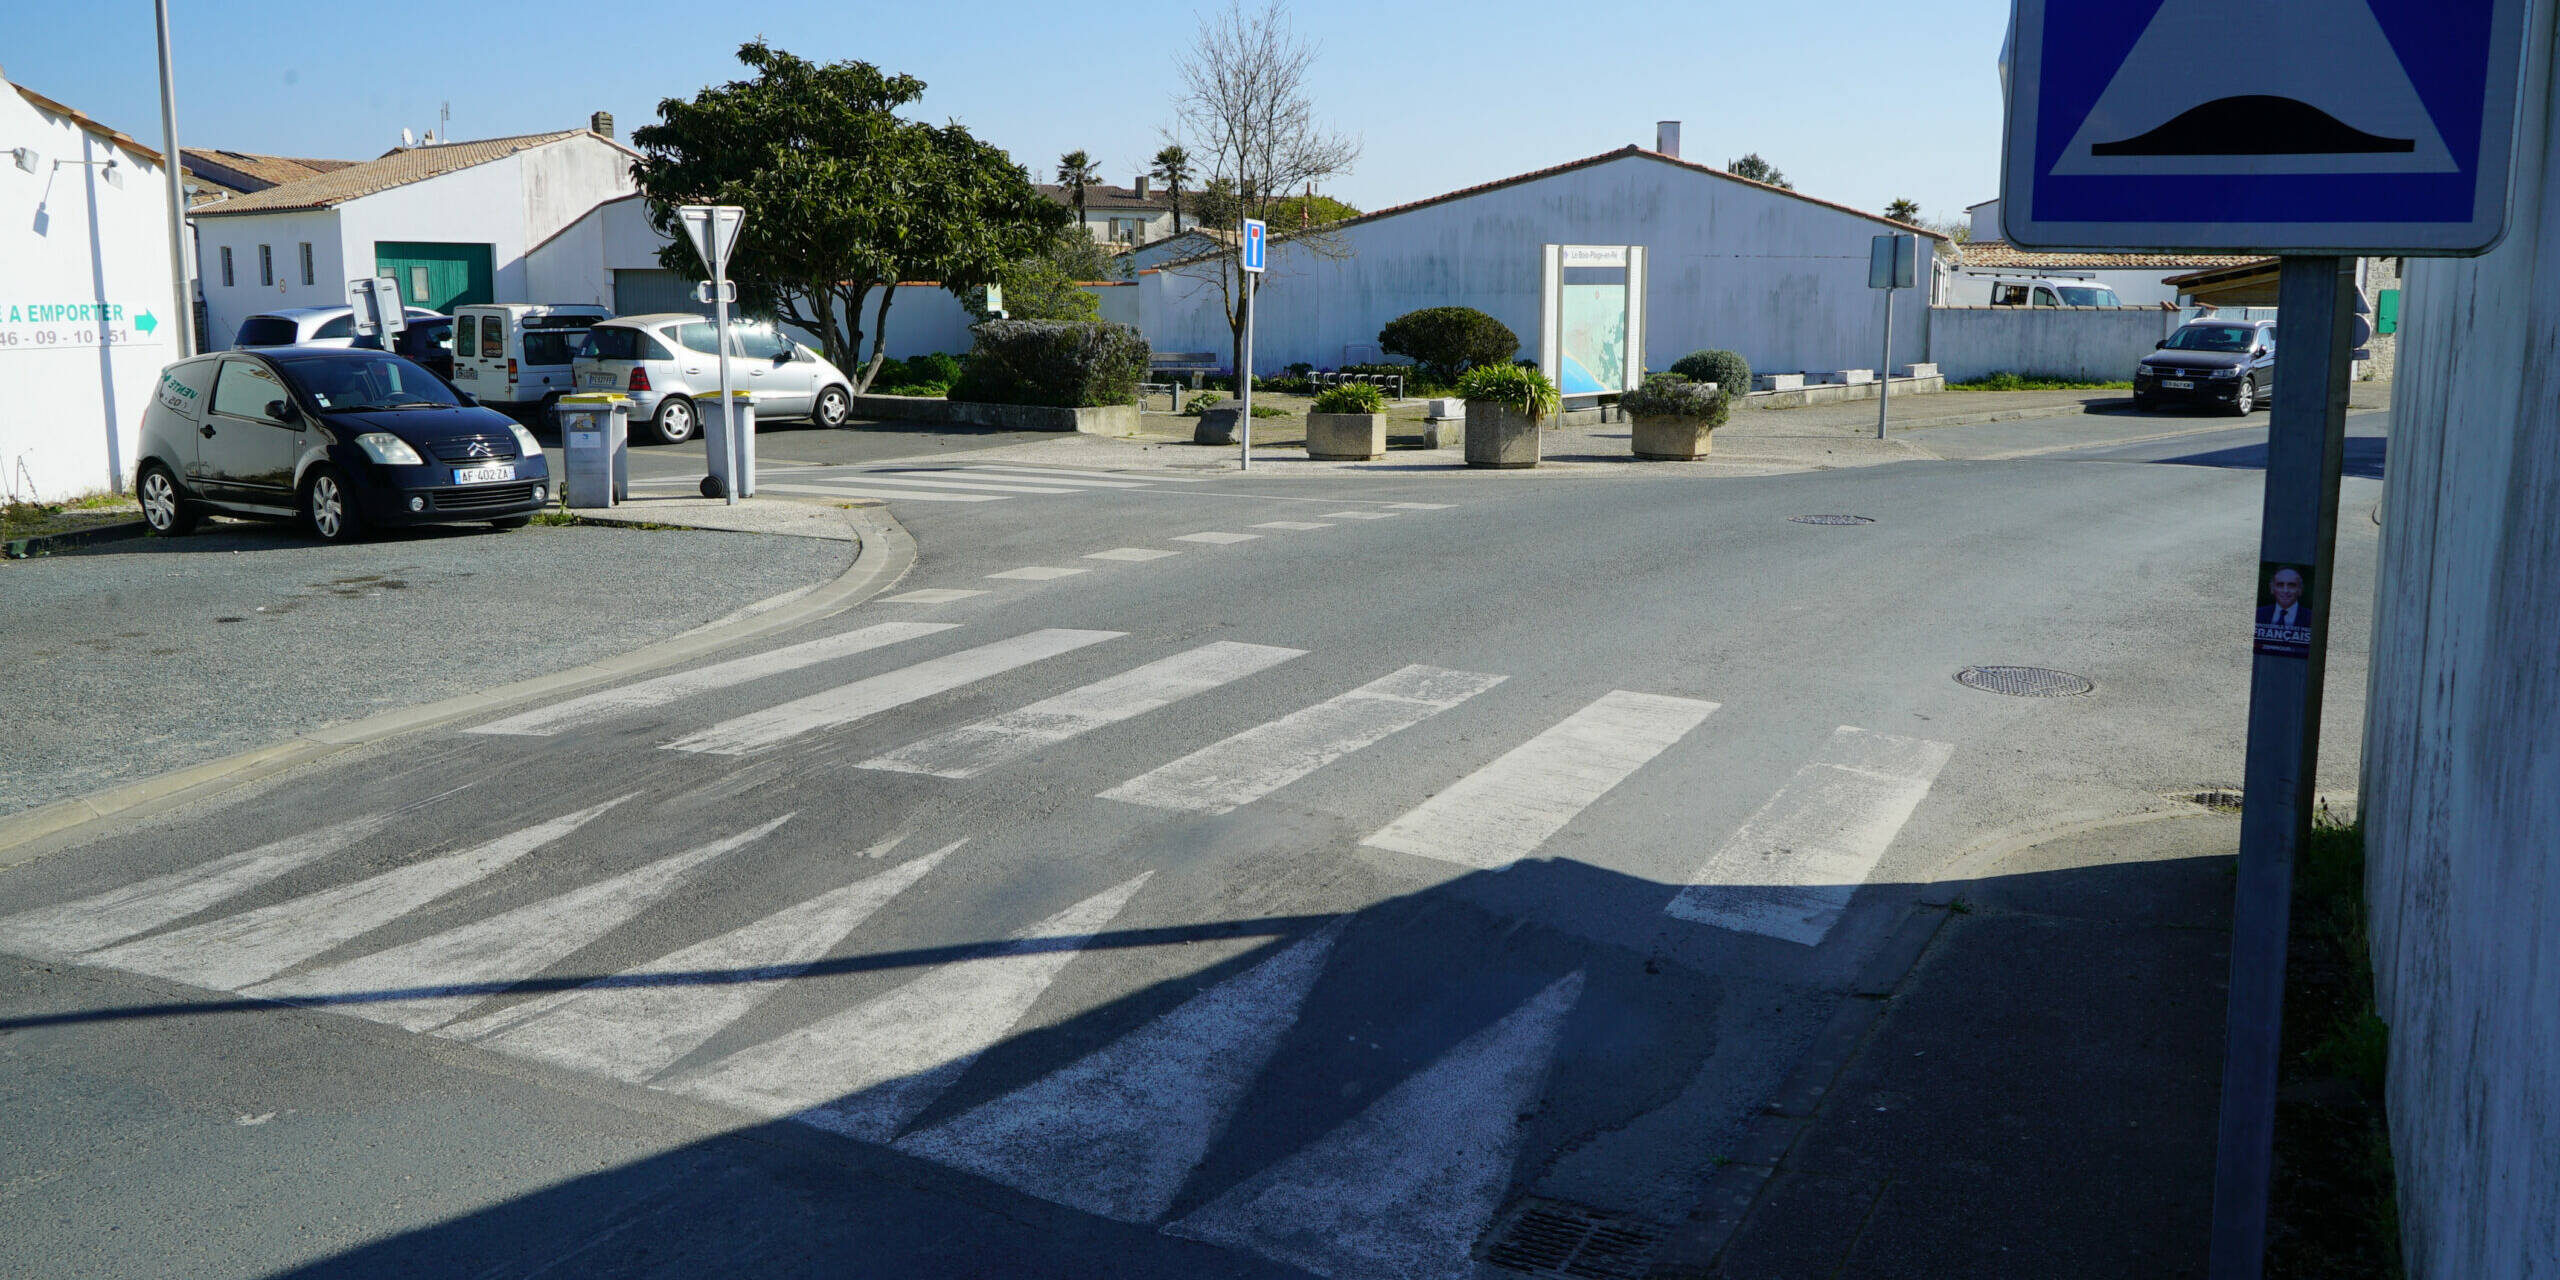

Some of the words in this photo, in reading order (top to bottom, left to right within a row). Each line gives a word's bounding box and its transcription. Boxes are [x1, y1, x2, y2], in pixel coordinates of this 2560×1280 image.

[9, 305, 22, 323] A
[28, 304, 123, 322] EMPORTER
[36, 330, 57, 345] 09
[74, 330, 93, 344] 10
[109, 329, 127, 343] 51
